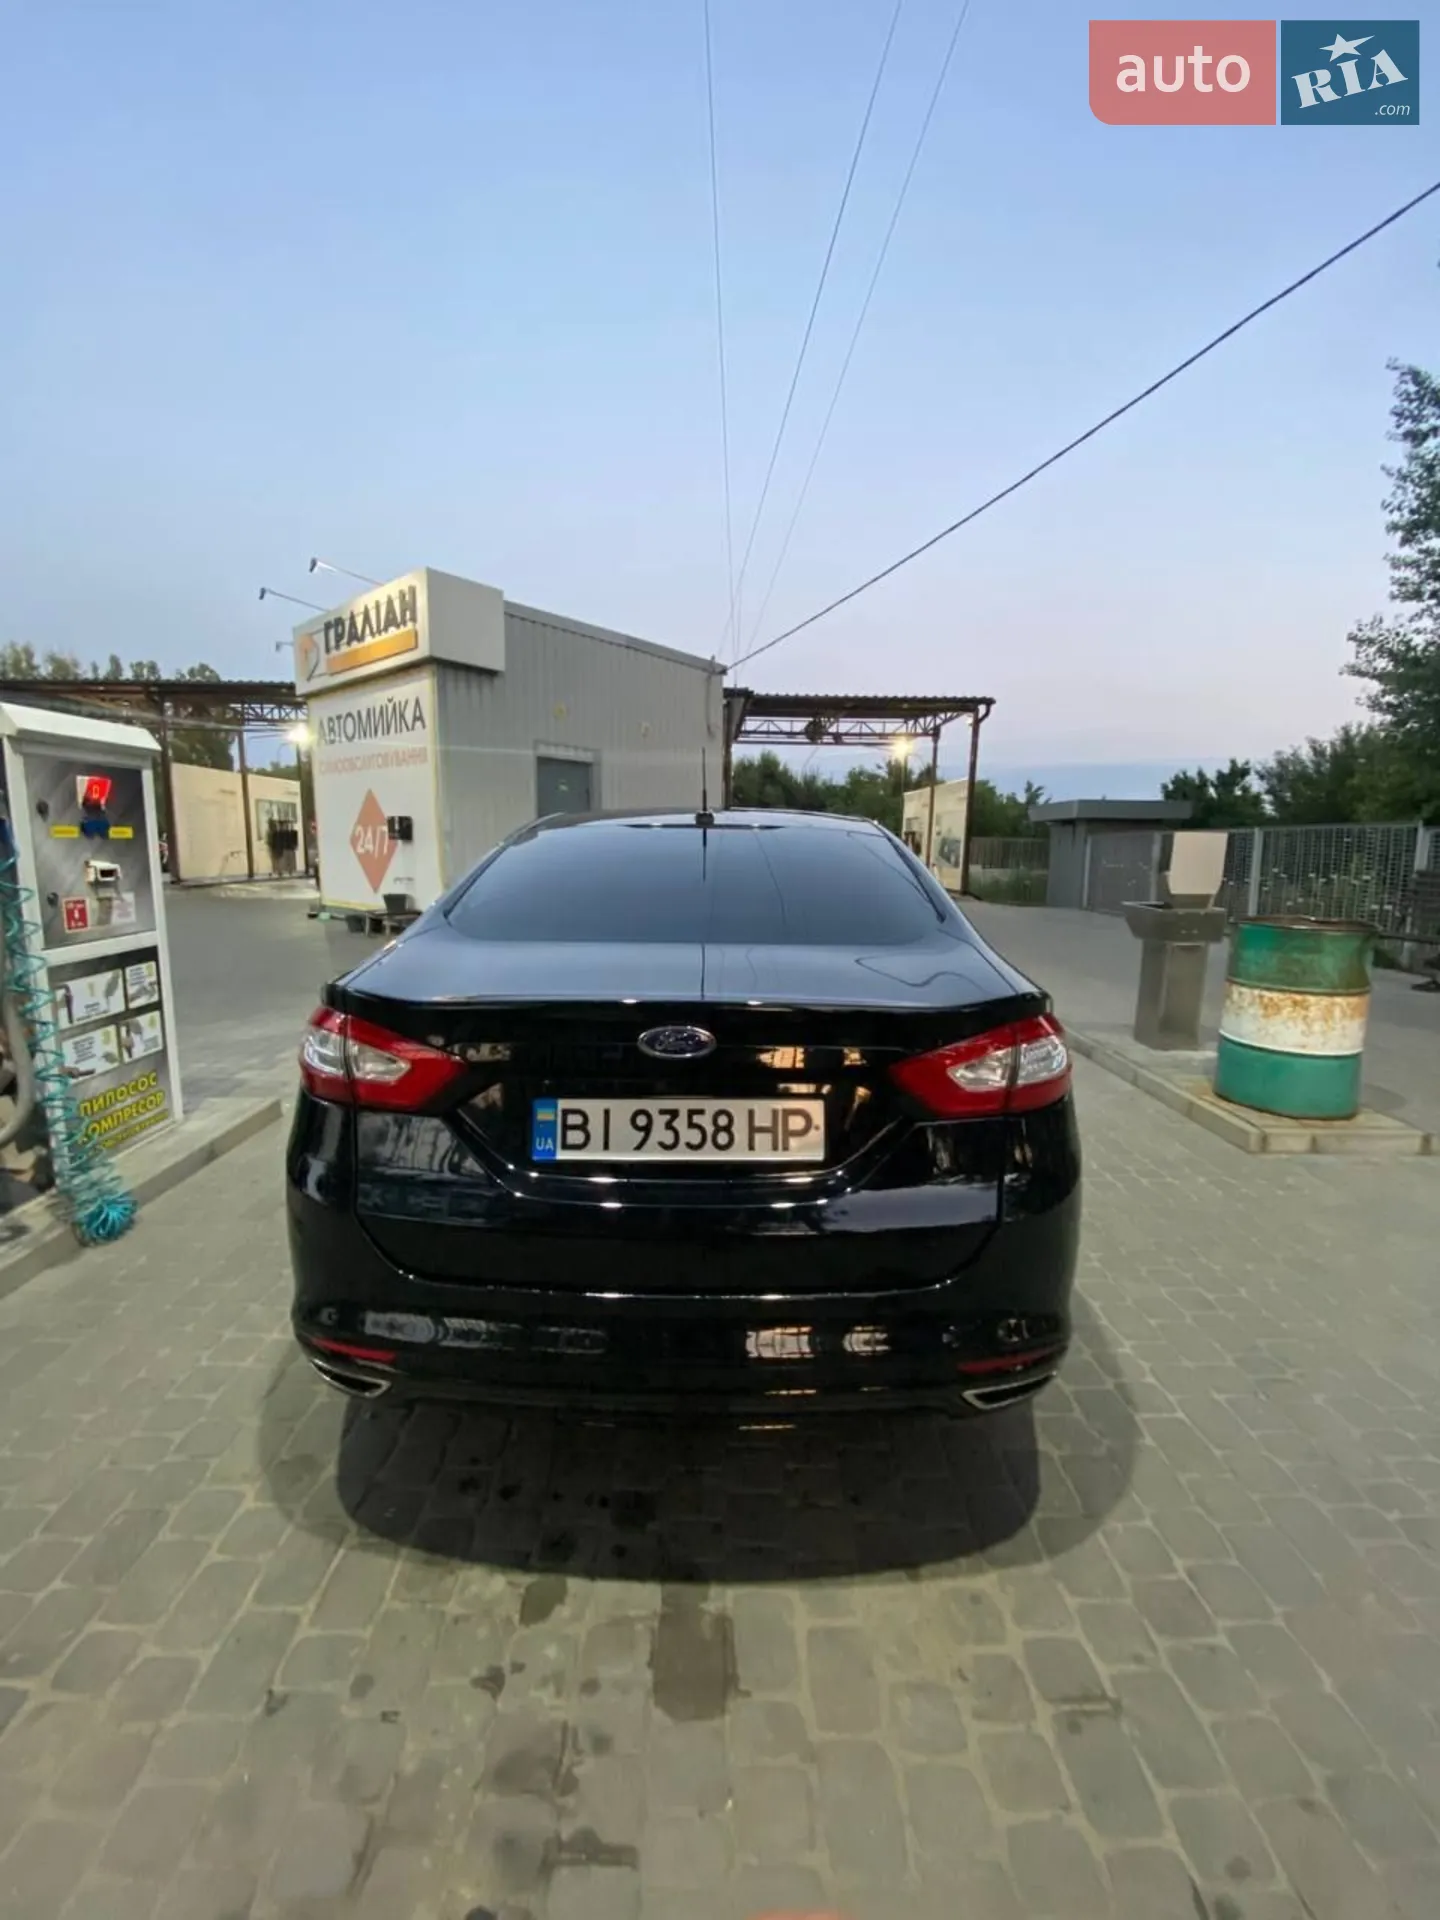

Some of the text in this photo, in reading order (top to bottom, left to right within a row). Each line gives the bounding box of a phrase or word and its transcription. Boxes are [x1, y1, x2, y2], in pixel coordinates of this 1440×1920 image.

[323, 585, 417, 655] ГРАЛІАН
[316, 696, 426, 747] АВТОМИЙКА
[355, 824, 388, 858] 24/7
[535, 1137, 555, 1151] UA
[560, 1107, 813, 1152] BI 9358 HP
